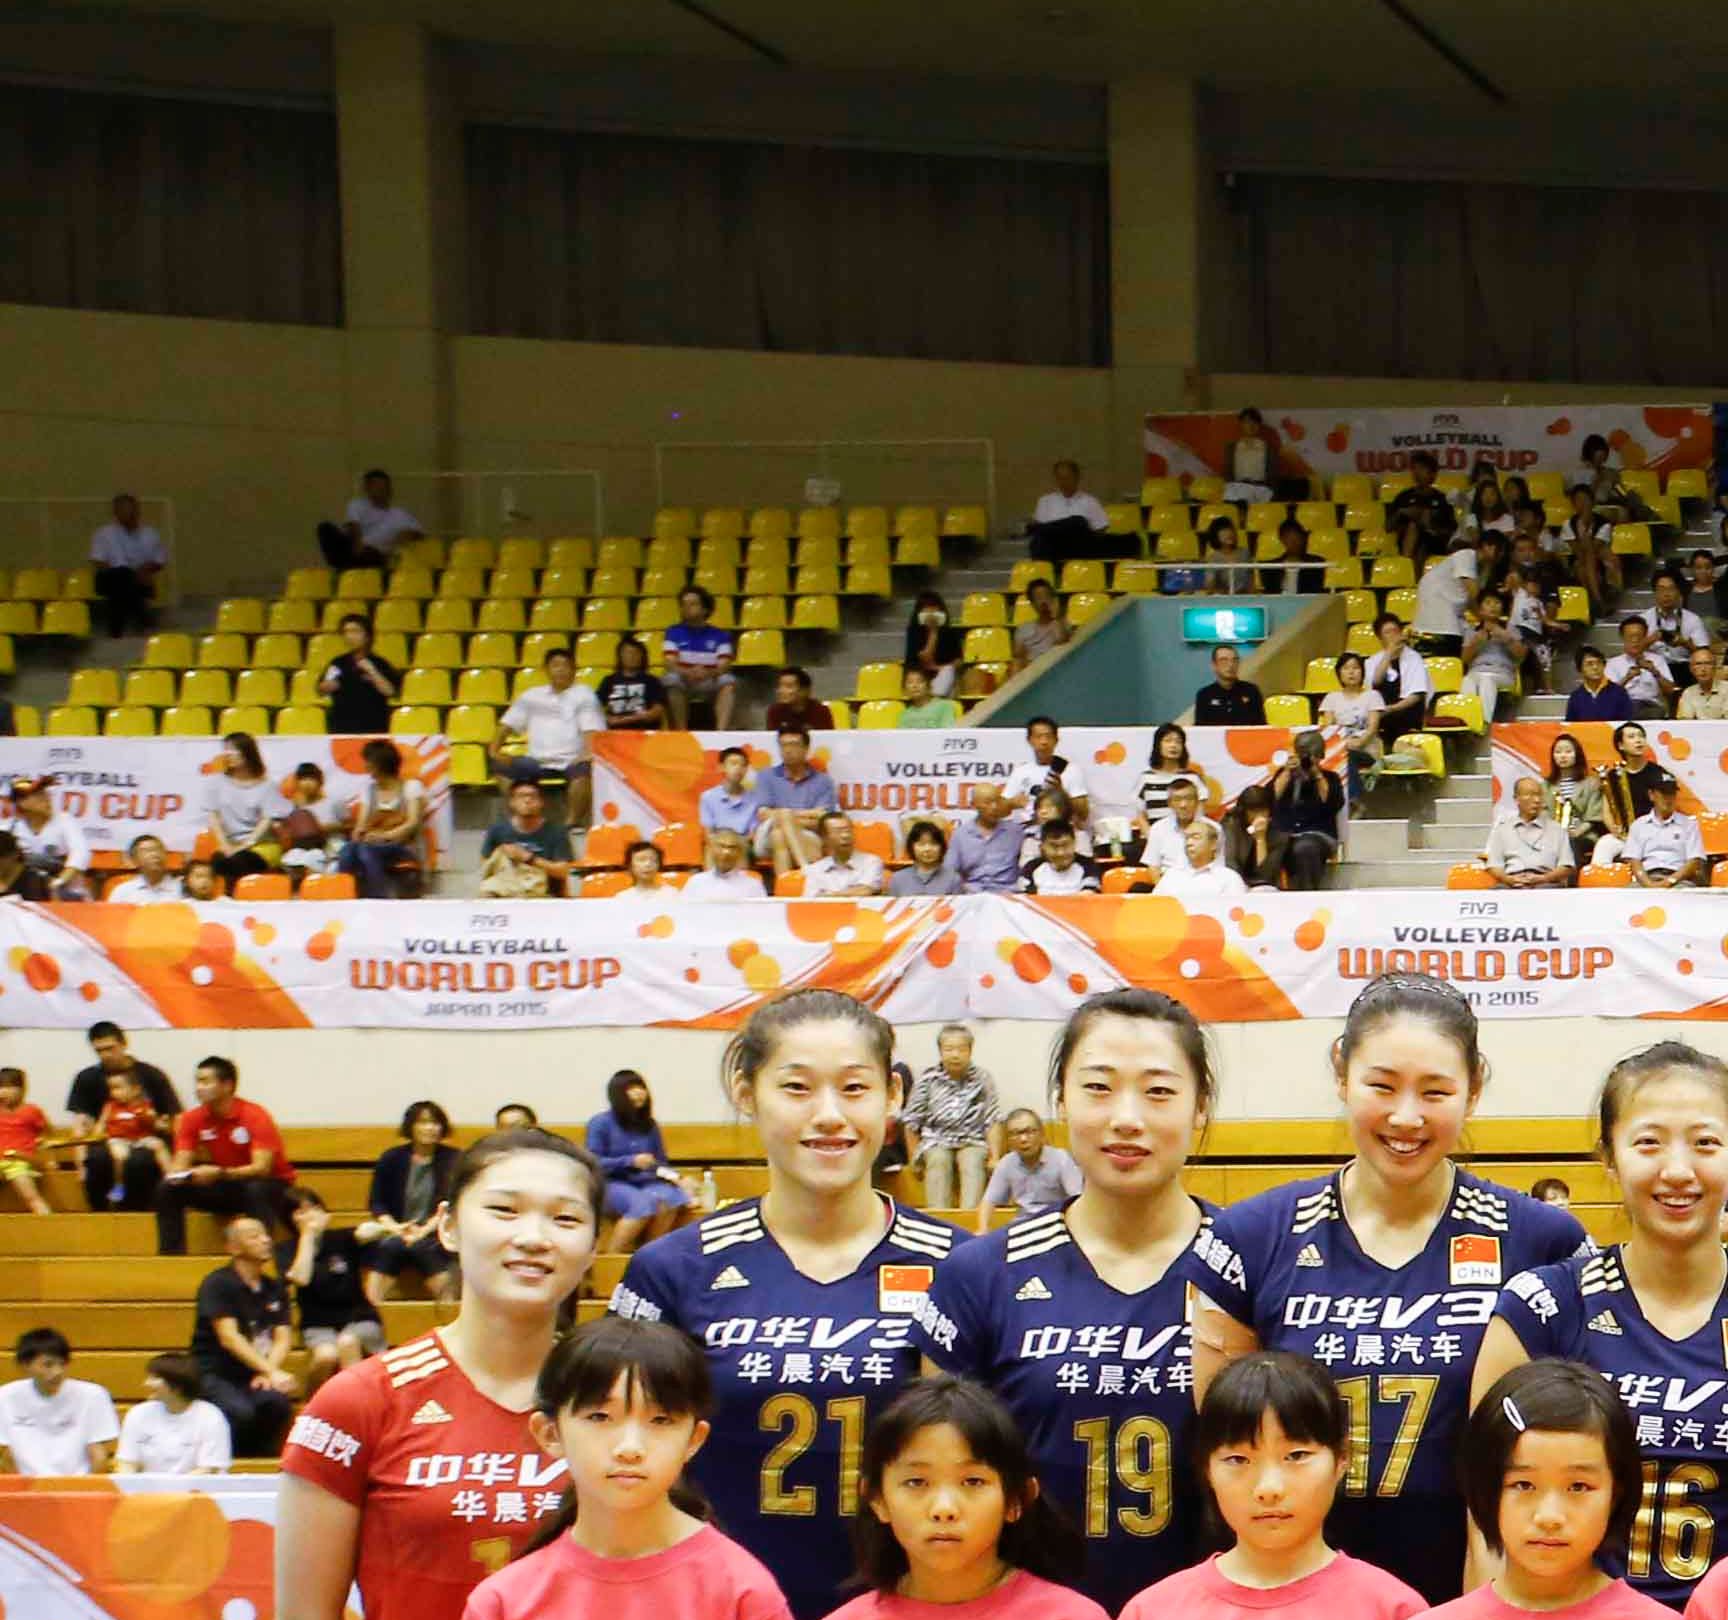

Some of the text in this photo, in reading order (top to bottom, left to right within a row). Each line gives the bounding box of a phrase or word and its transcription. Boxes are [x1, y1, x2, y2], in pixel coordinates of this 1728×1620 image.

[101, 792, 183, 820] CUP
[1458, 902, 1498, 916] FIVB
[403, 937, 568, 955] VOLLEYBALL
[1392, 926, 1560, 943] VOLLEYBALL
[351, 957, 622, 993] WORLD CUP
[1518, 946, 1615, 982] CUP
[1487, 990, 1540, 1006] 2015
[1456, 1265, 1497, 1280] CHN
[1283, 1290, 1499, 1330] 中华V3
[1313, 1331, 1464, 1366] 华晨汽车
[738, 1352, 895, 1386] 华晨汽车
[1056, 1362, 1195, 1397] 华晨汽车
[1335, 1373, 1441, 1499] 17
[758, 1392, 866, 1518] 21
[1072, 1414, 1174, 1540] 19
[1626, 1459, 1720, 1584] 16
